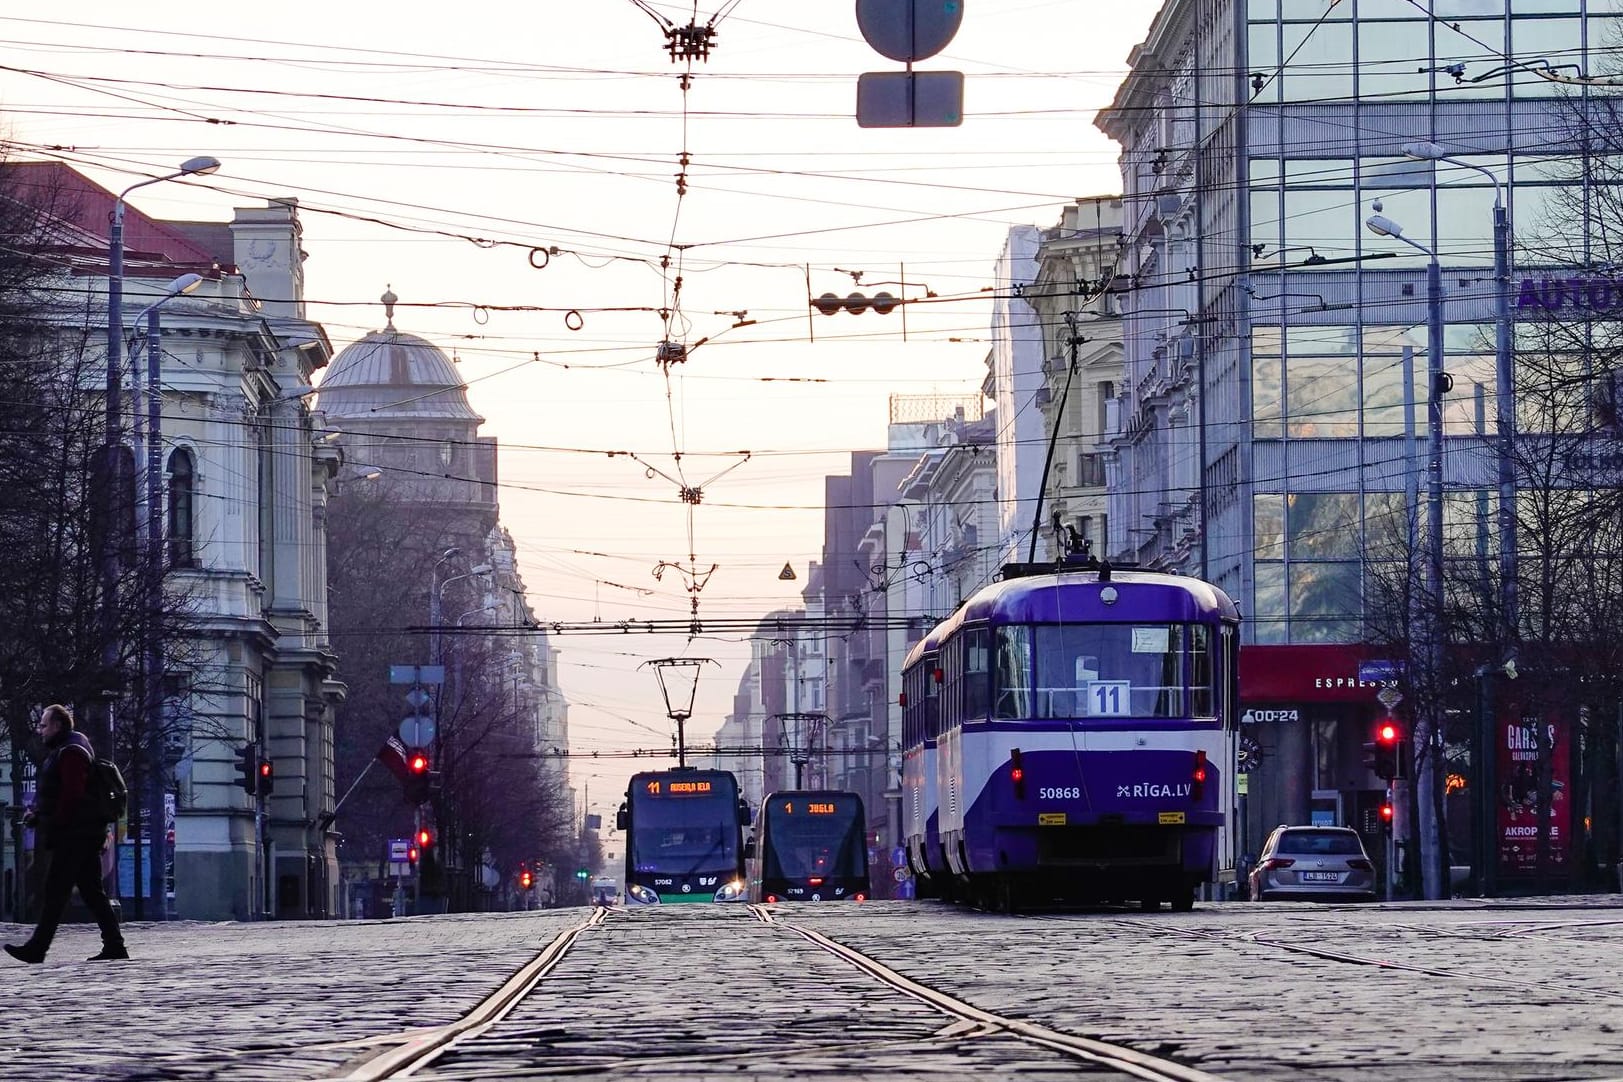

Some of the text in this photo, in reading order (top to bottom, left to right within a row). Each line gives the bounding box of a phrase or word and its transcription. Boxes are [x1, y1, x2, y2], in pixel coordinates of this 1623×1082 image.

[1097, 686, 1119, 713] 11
[647, 782, 660, 794] 11
[1039, 787, 1080, 799] 50868
[1134, 782, 1191, 797] RĪGA.LV
[785, 802, 792, 814] 1
[808, 803, 834, 813] JUGLA
